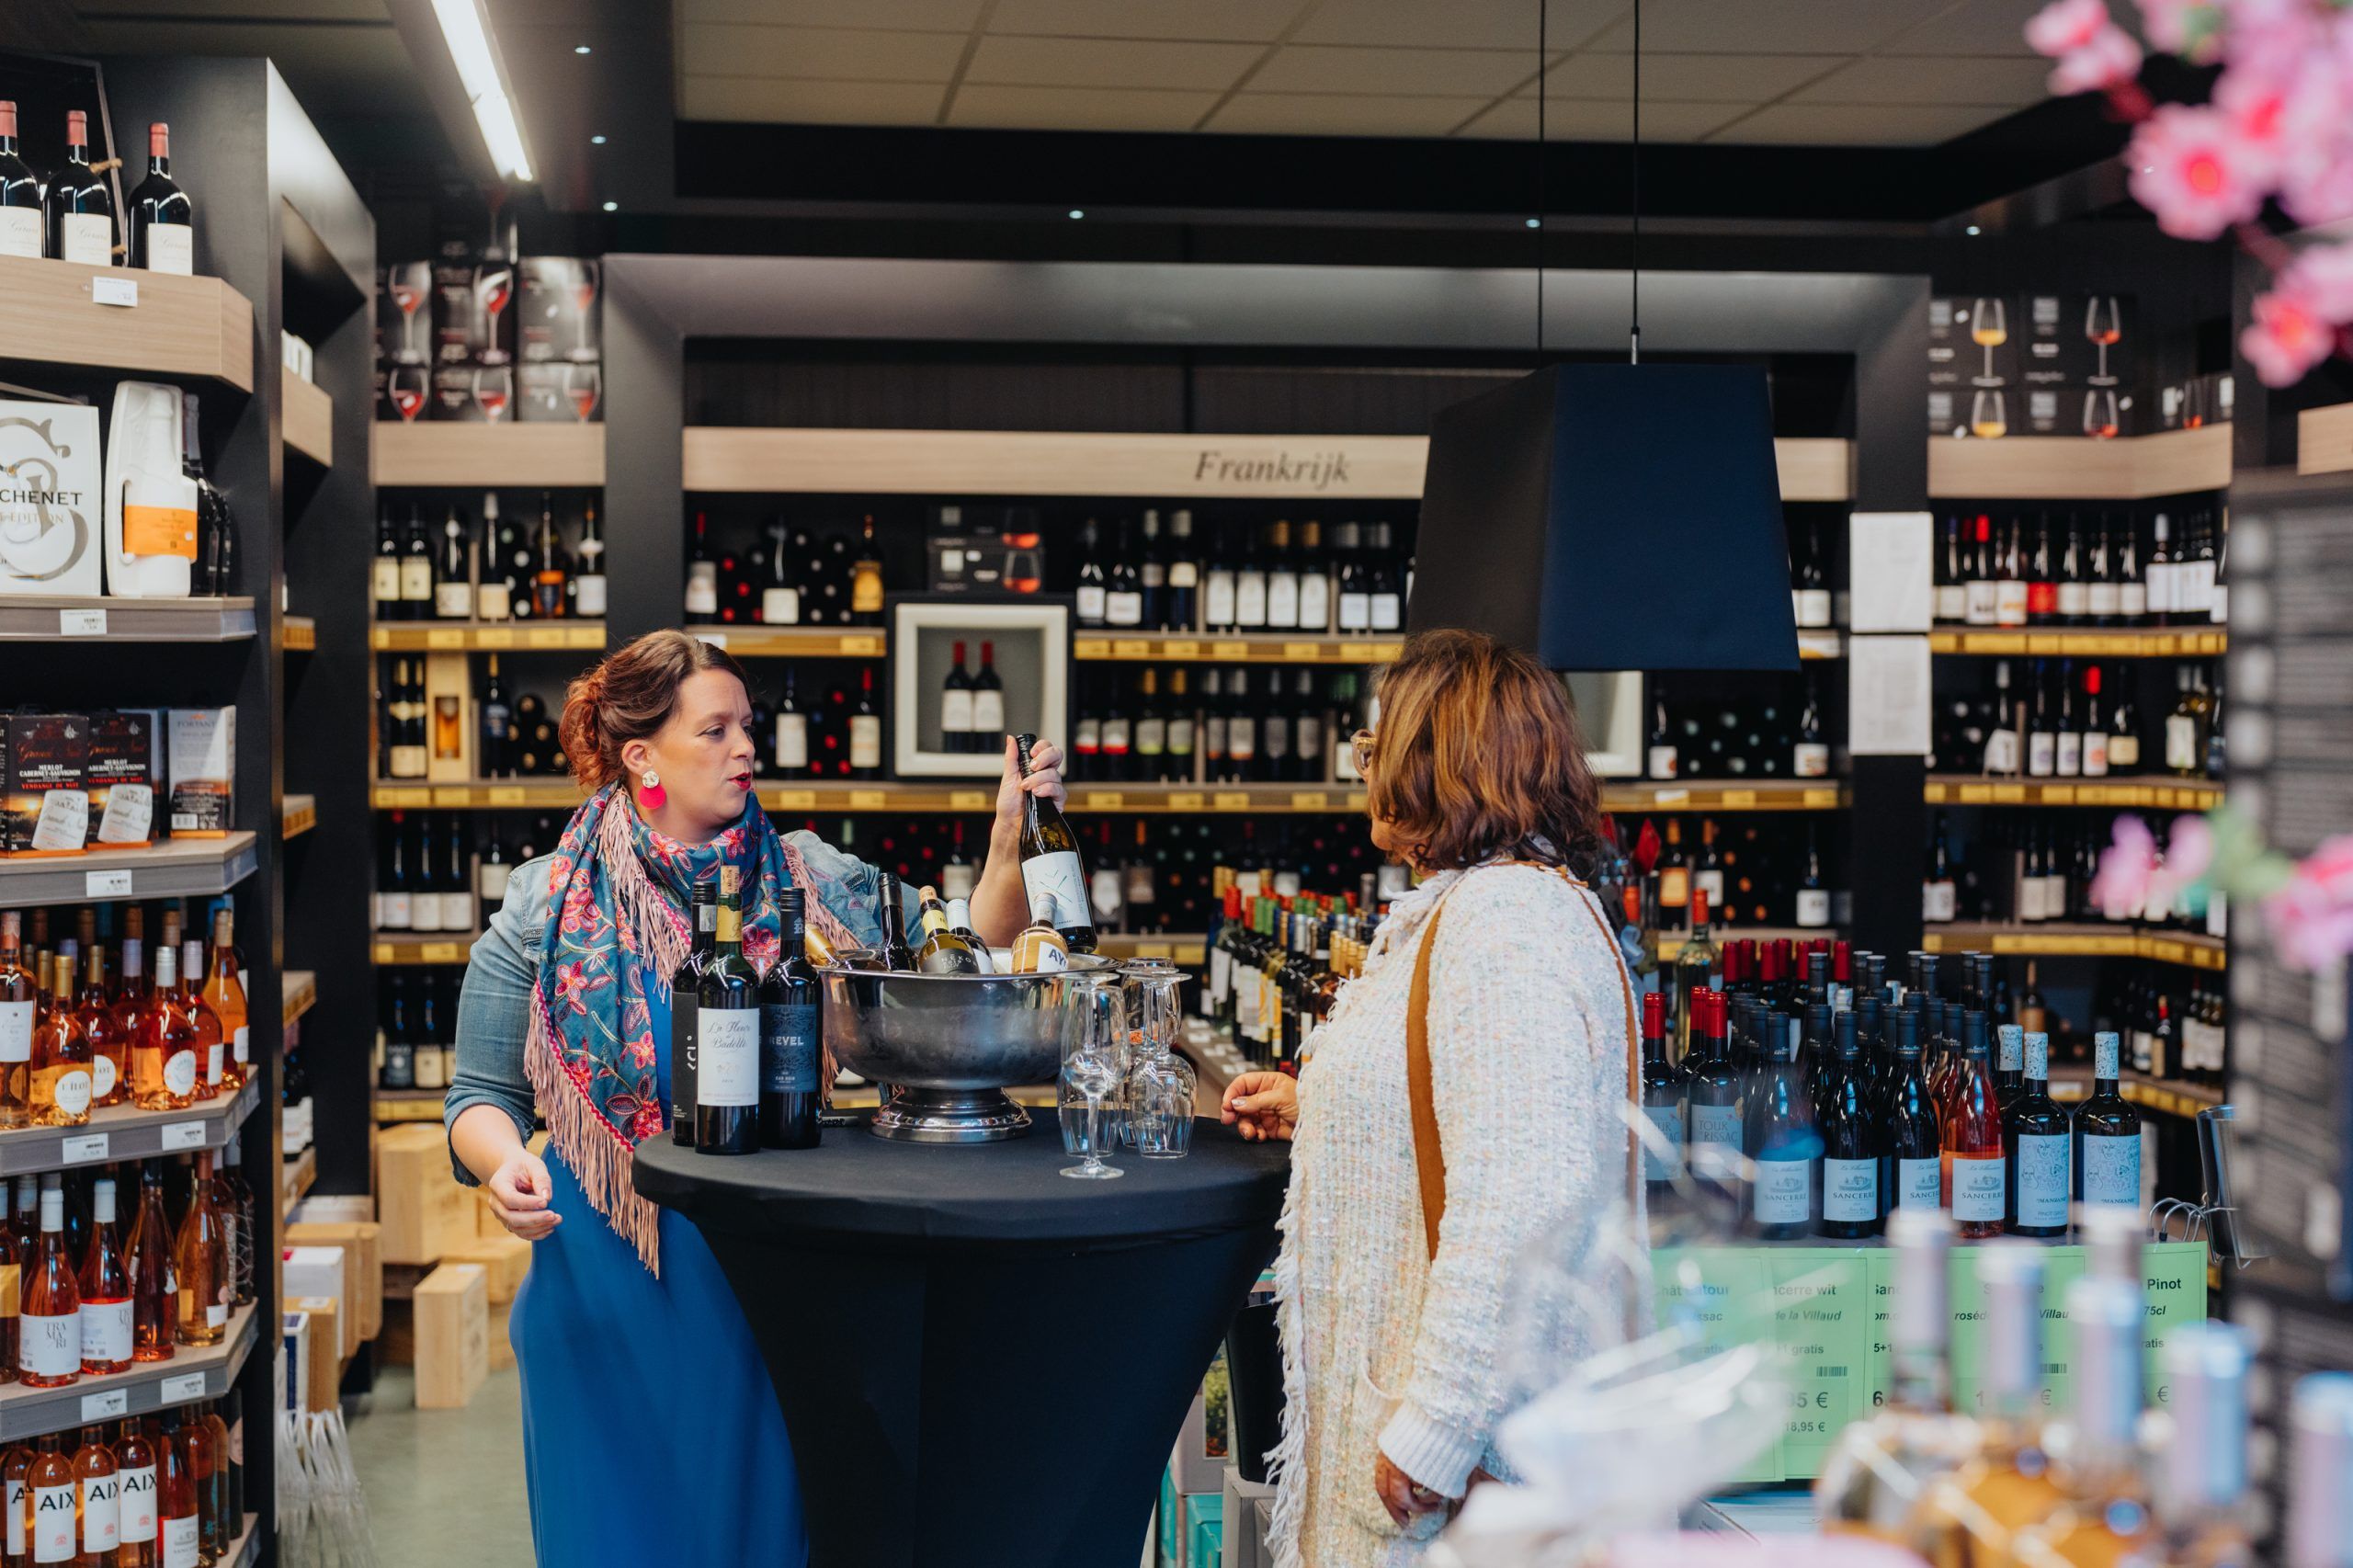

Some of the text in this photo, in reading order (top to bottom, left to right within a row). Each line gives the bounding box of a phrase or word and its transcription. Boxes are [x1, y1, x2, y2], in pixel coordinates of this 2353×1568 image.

[1194, 450, 1351, 491] Frankrijk
[88, 764, 146, 772] ABERNET-SAUVIGNON
[768, 1035, 805, 1047] REVEL
[1818, 1284, 1836, 1296] wit
[2147, 1278, 2182, 1290] Pinot
[1803, 1311, 1842, 1322] Villaud
[1792, 1343, 1824, 1356] gratis
[40, 1492, 75, 1511] AIX
